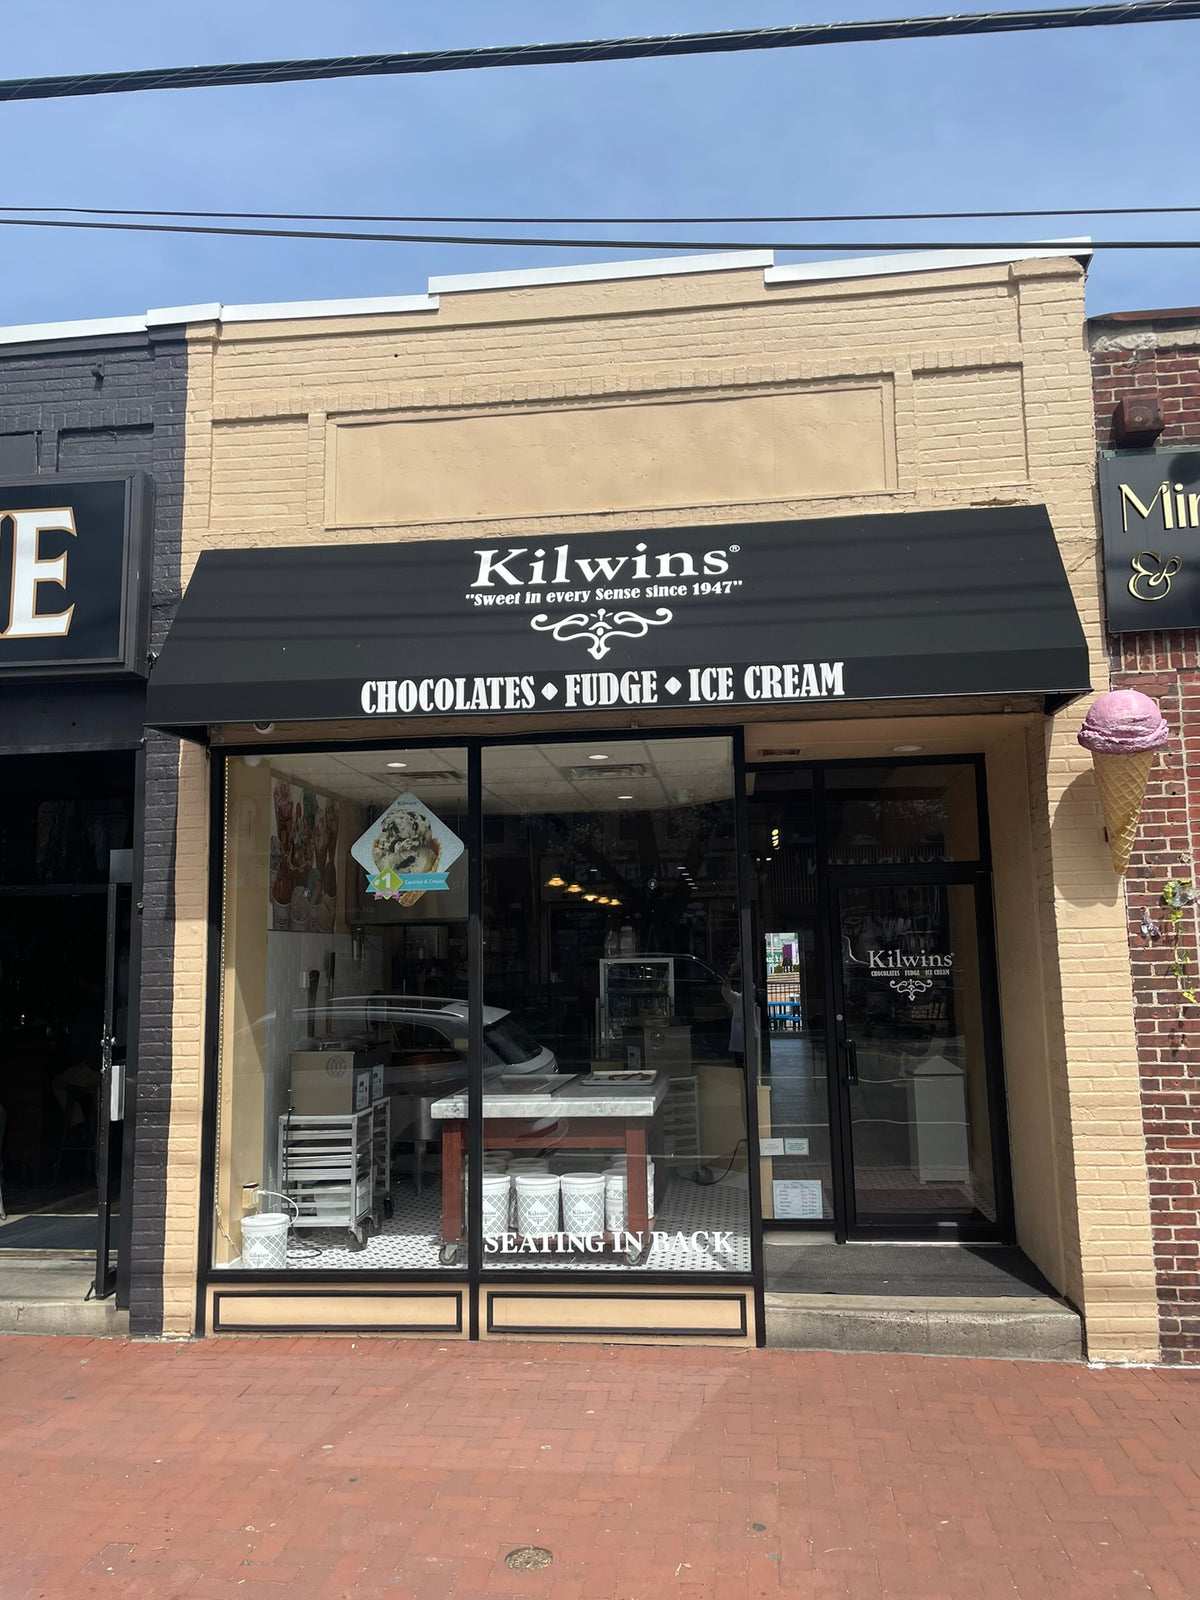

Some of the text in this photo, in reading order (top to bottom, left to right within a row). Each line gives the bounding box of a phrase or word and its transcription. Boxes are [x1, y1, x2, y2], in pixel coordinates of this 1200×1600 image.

[0, 507, 77, 639] E
[1128, 551, 1182, 601] &
[524, 591, 542, 604] in
[545, 589, 592, 604] every
[595, 587, 641, 601] Sense
[645, 584, 688, 598] since
[360, 662, 846, 714] CHOCOLATES FUDGE ICE CREAM
[867, 948, 953, 968] Kilwins
[483, 1230, 735, 1254] SEATING IN BACK
